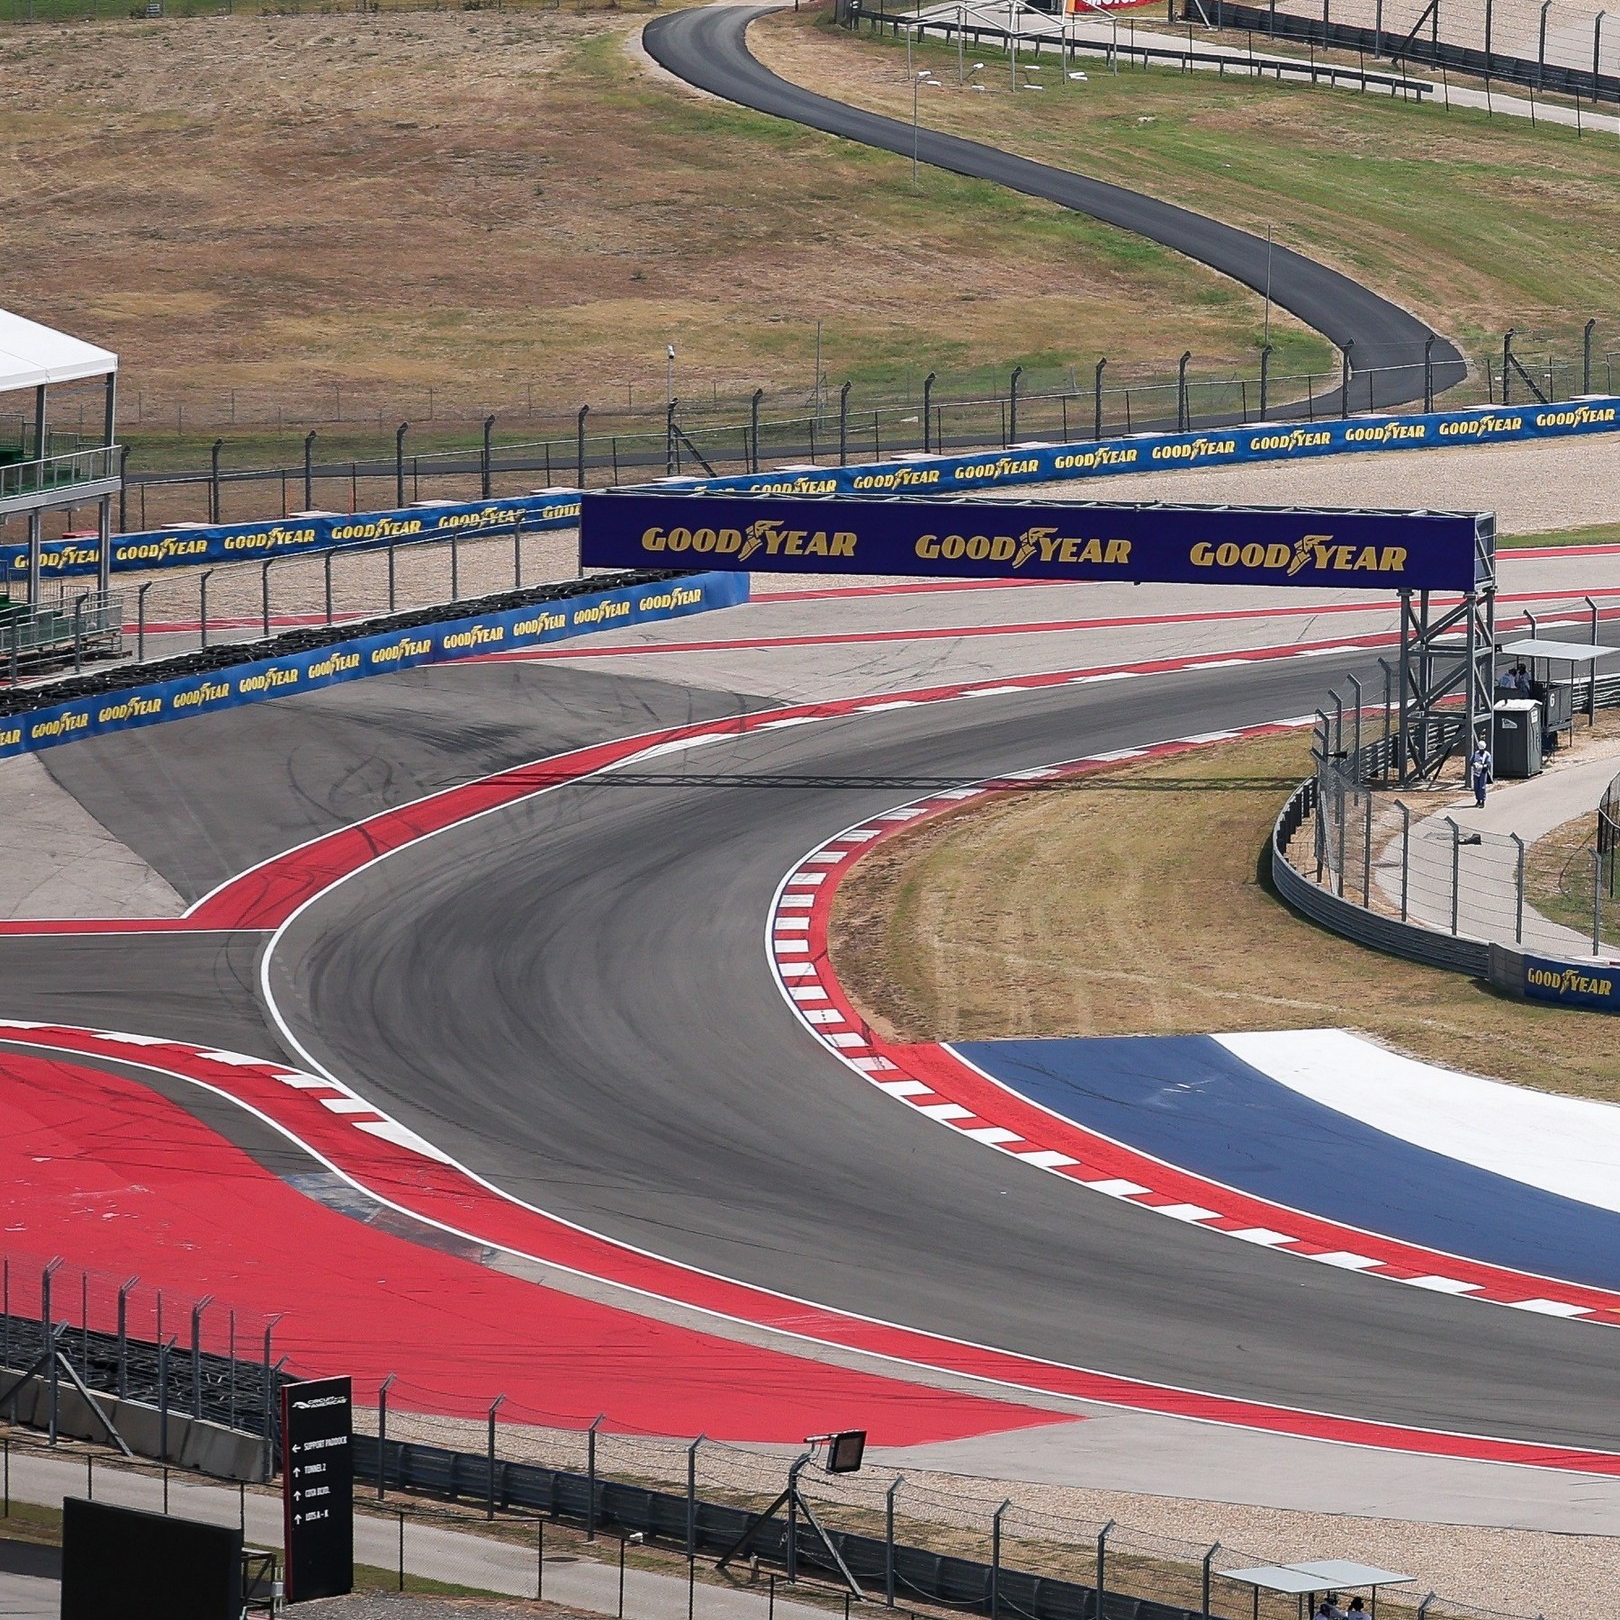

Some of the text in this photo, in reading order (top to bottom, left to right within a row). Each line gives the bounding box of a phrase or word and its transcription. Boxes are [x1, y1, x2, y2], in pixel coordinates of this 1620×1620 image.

[853, 468, 940, 490] GOODYEAR
[955, 458, 1039, 479] GOODYEAR
[1055, 447, 1137, 469] GOODYEAR
[1152, 439, 1235, 460] GOODYEAR
[1251, 430, 1331, 451] GOODYEAR
[1345, 423, 1425, 443] GOODYEAR
[1439, 415, 1522, 437] GOODYEAR
[1536, 406, 1616, 428] GOODYEAR
[117, 537, 207, 560] GOODYEAR
[225, 528, 315, 550] GOODYEAR
[331, 518, 421, 540] GOODYEAR
[642, 519, 1408, 576] GOODYEAR GOODYEAR GOODYEAR
[32, 712, 89, 738] GOODYEAR
[98, 696, 162, 722] GOODYEAR
[173, 682, 230, 707] GOODYEAR
[239, 667, 298, 692] GOODYEAR
[308, 652, 360, 678] GOODYEAR
[371, 638, 431, 663] GOODYEAR
[443, 624, 504, 648] GOODYEAR
[513, 611, 566, 636] GOODYEAR
[573, 600, 630, 625] GOODYEAR
[639, 587, 701, 611] GOODYEAR
[1549, 693, 1556, 707] 6
[1528, 968, 1612, 995] GOODYEAR
[304, 1435, 348, 1451] SUPPORT PADDOCK
[304, 1463, 322, 1474] TUNNEL
